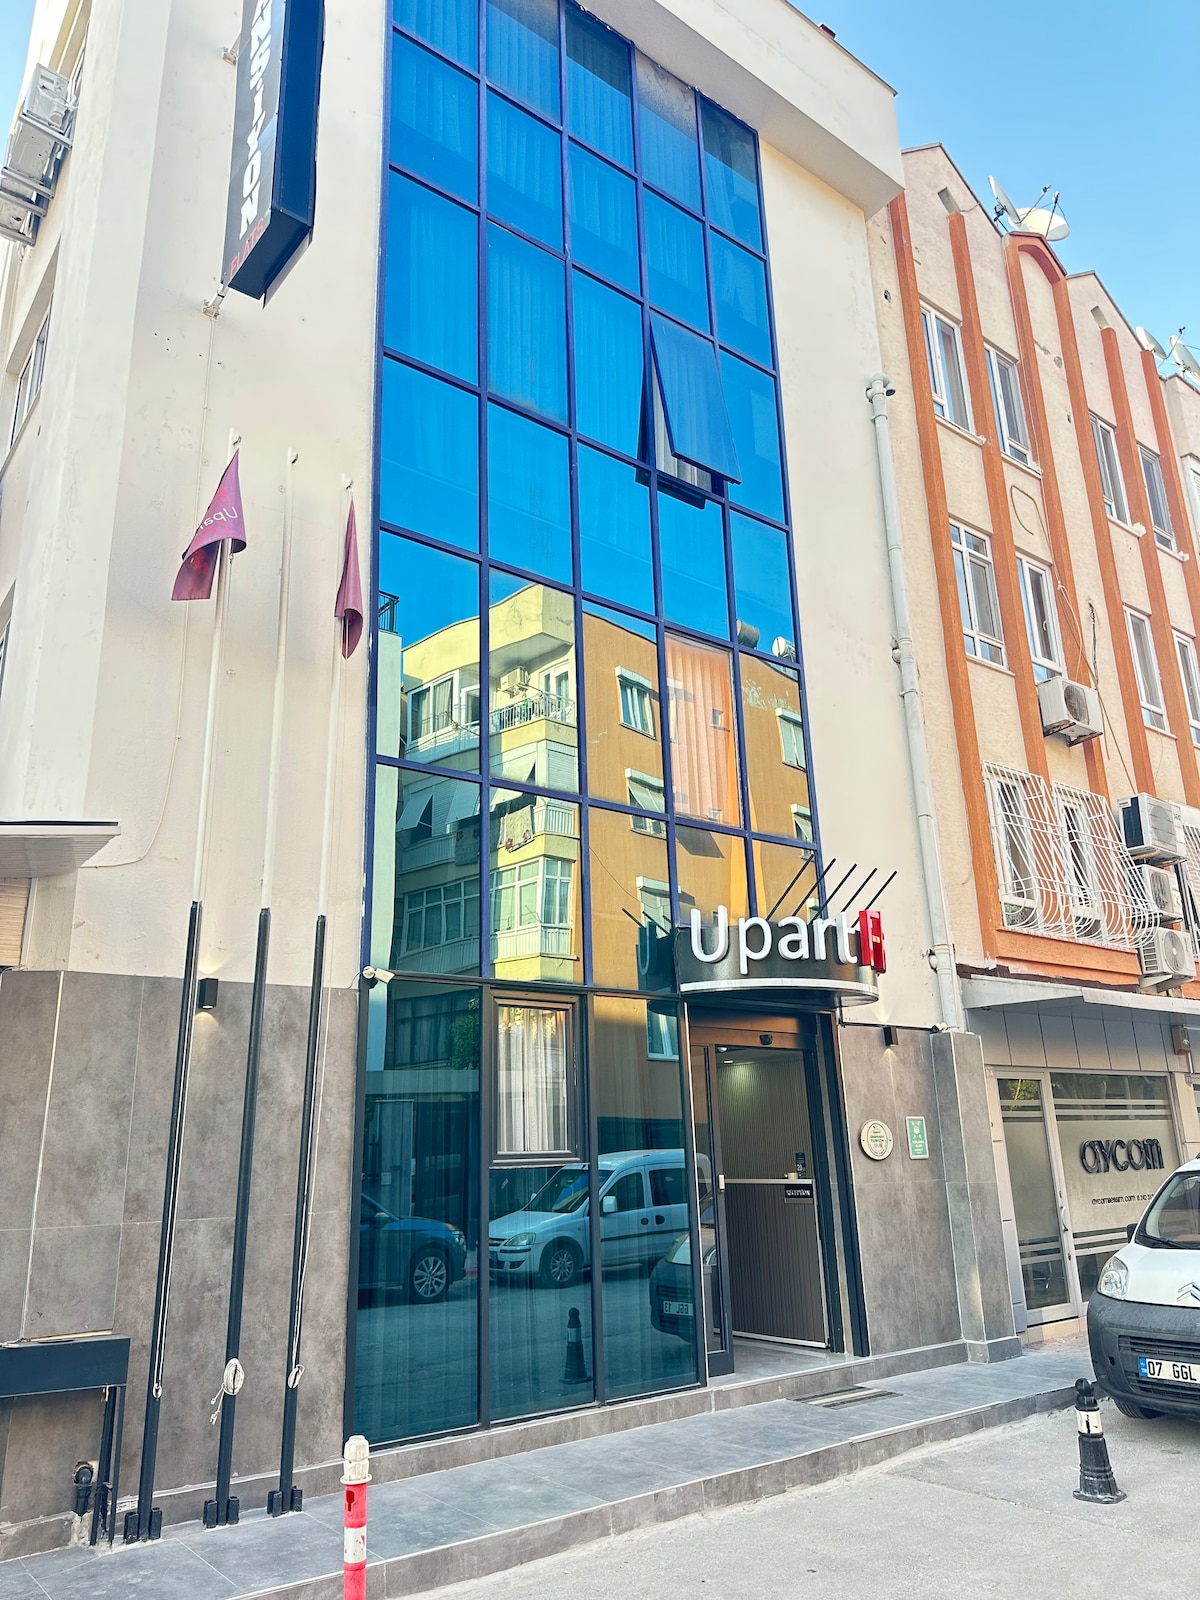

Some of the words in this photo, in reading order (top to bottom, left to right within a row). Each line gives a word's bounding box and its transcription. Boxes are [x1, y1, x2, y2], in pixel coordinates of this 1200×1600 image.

[229, 216, 265, 280] FLATS
[690, 905, 858, 975] Upart
[1148, 1361, 1162, 1377] 07
[1172, 1363, 1197, 1382] GGL
